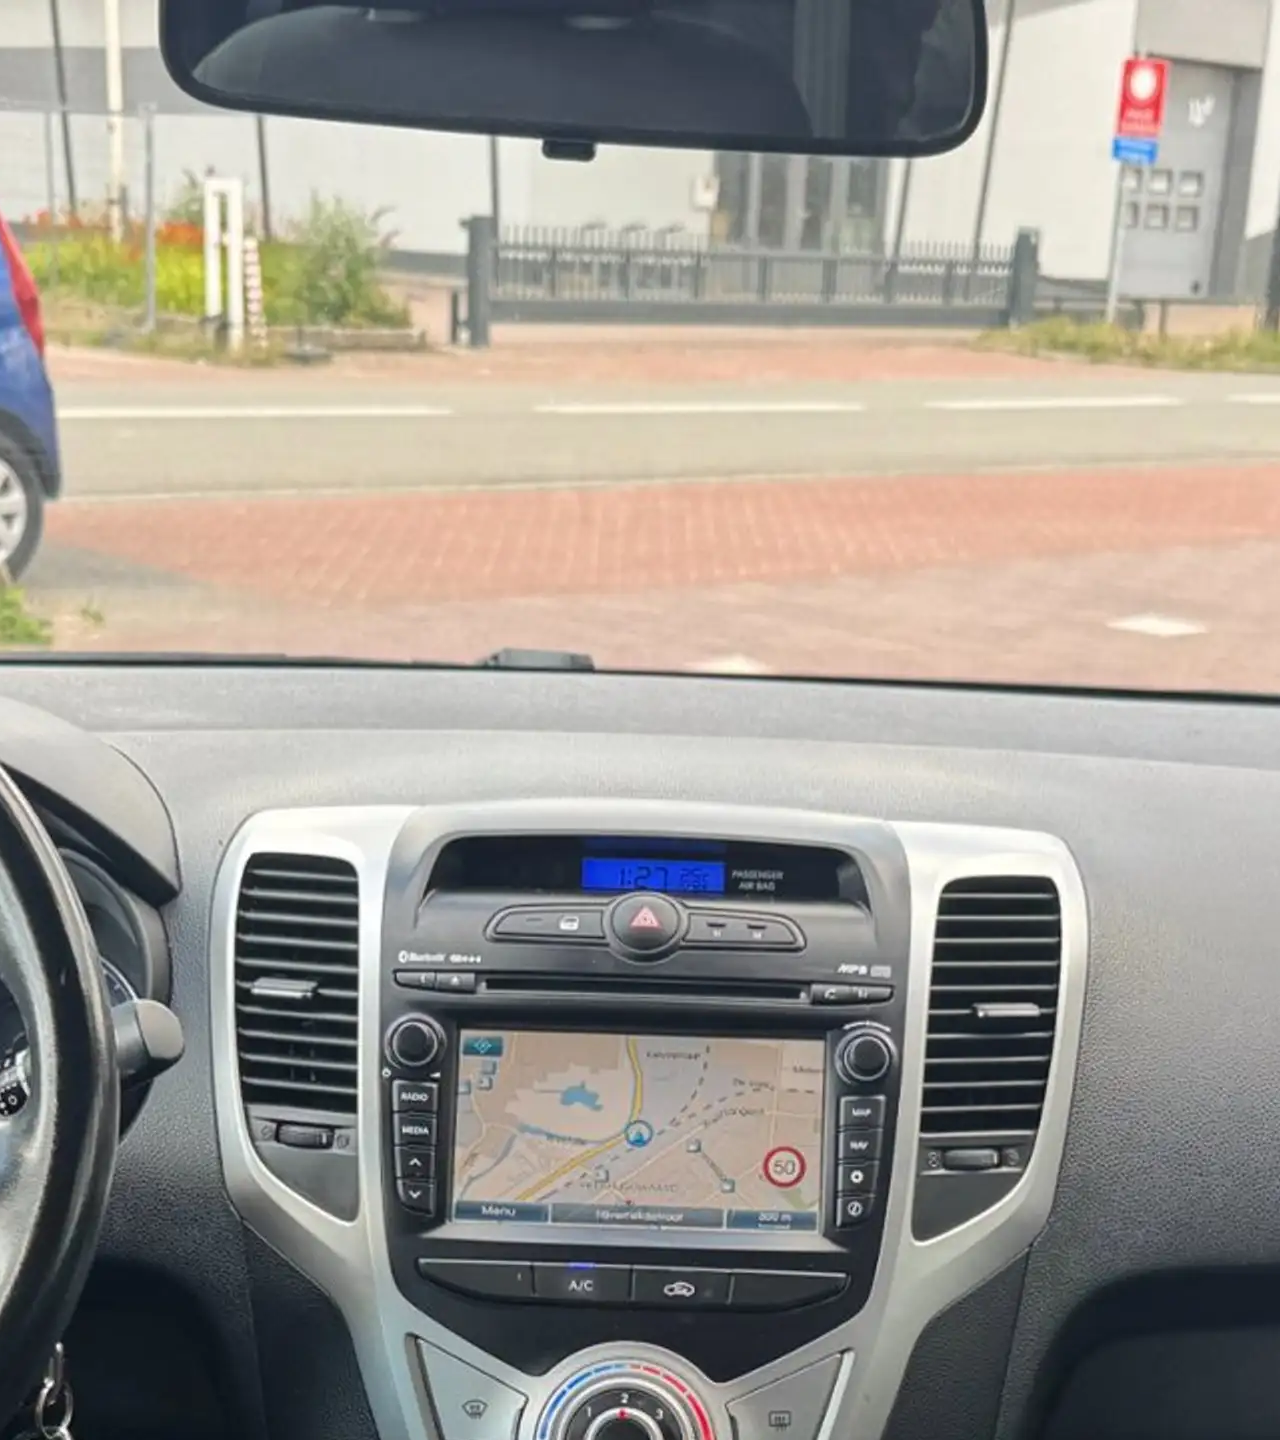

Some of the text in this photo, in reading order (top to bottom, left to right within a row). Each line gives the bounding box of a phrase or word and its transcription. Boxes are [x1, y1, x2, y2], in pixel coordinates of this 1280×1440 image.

[731, 869, 785, 880] PASSENGER
[738, 881, 776, 891] AIR BAG
[400, 1091, 429, 1102] RADIO
[402, 1125, 429, 1136] MEDIA
[849, 1140, 869, 1150] NAV
[773, 1160, 796, 1176] 50
[481, 1205, 517, 1218] Menu
[569, 1279, 594, 1292] A/C
[621, 1393, 629, 1404] 2
[585, 1407, 592, 1417] 1
[656, 1408, 664, 1419] 3
